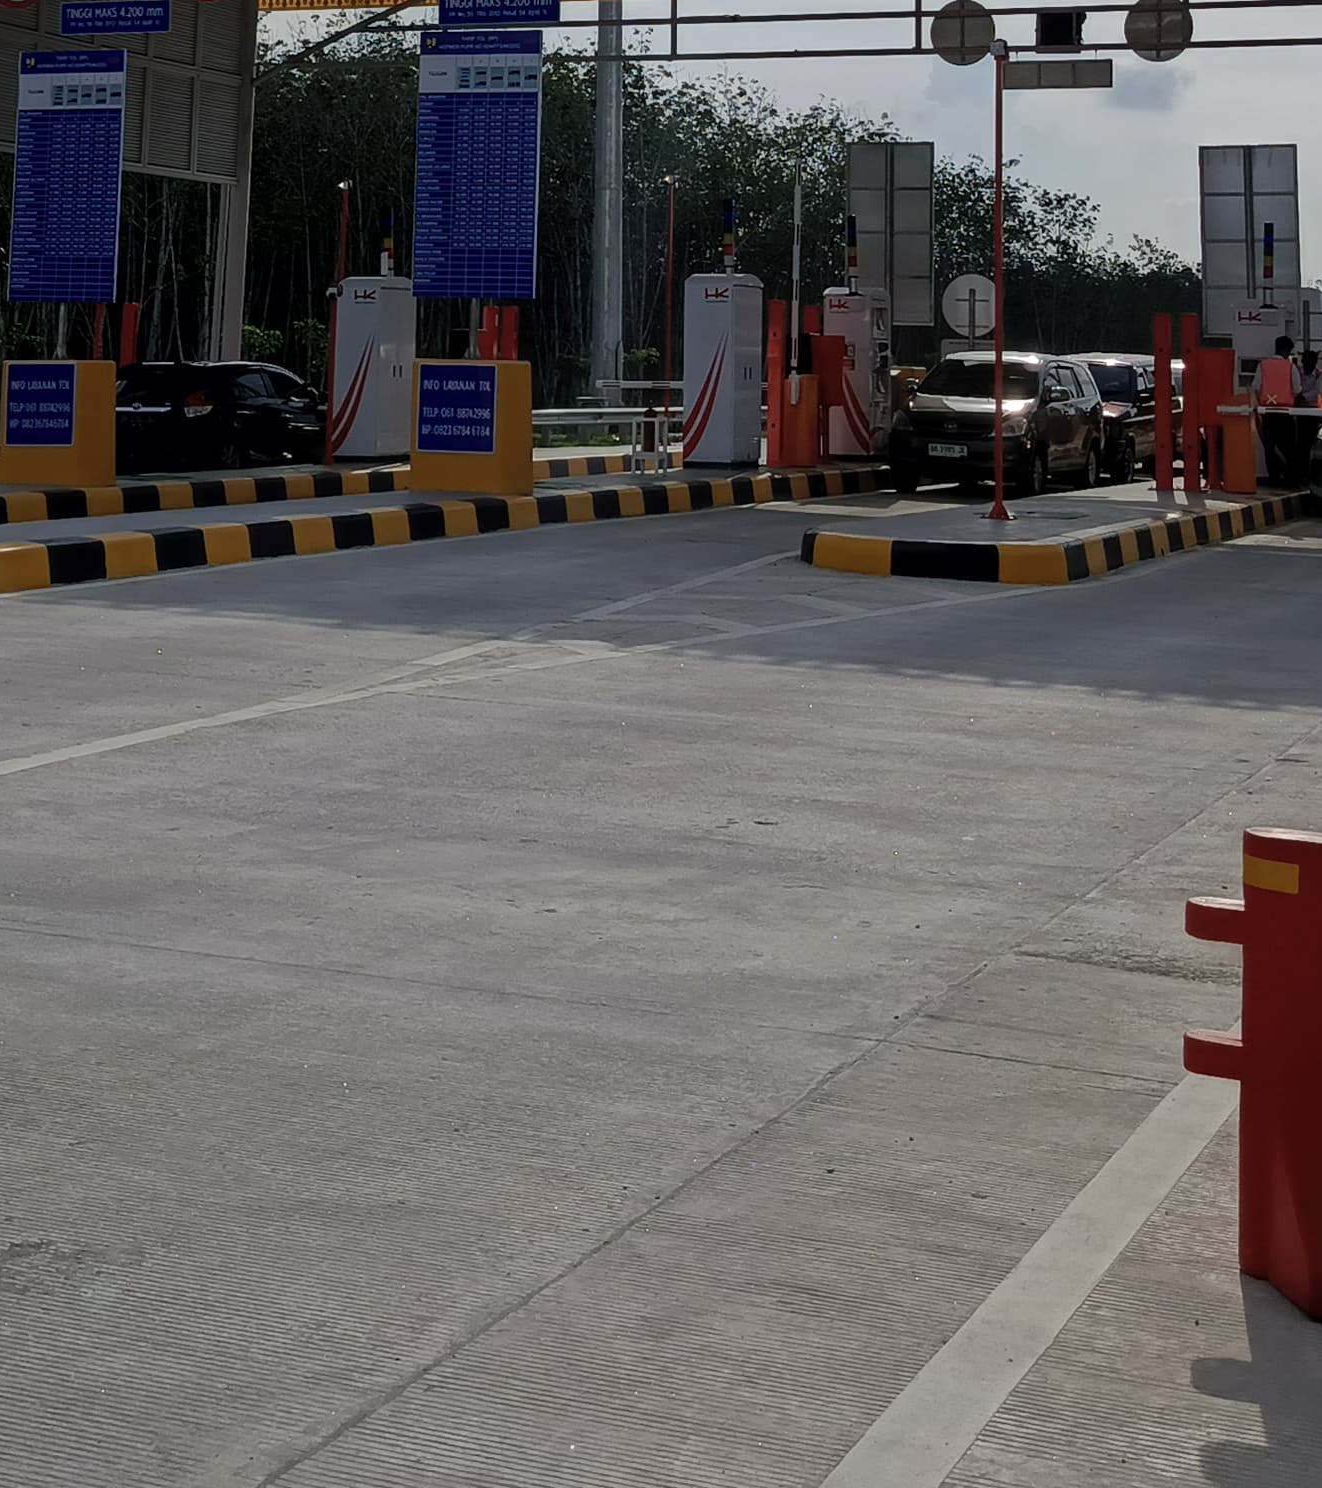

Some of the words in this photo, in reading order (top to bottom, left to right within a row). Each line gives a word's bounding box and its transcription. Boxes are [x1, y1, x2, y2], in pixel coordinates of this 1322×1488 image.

[66, 8, 92, 19] TINGGI
[94, 7, 118, 18] MAKS
[146, 7, 164, 17] mm
[10, 379, 26, 390] INFO
[423, 379, 440, 391] INFO
